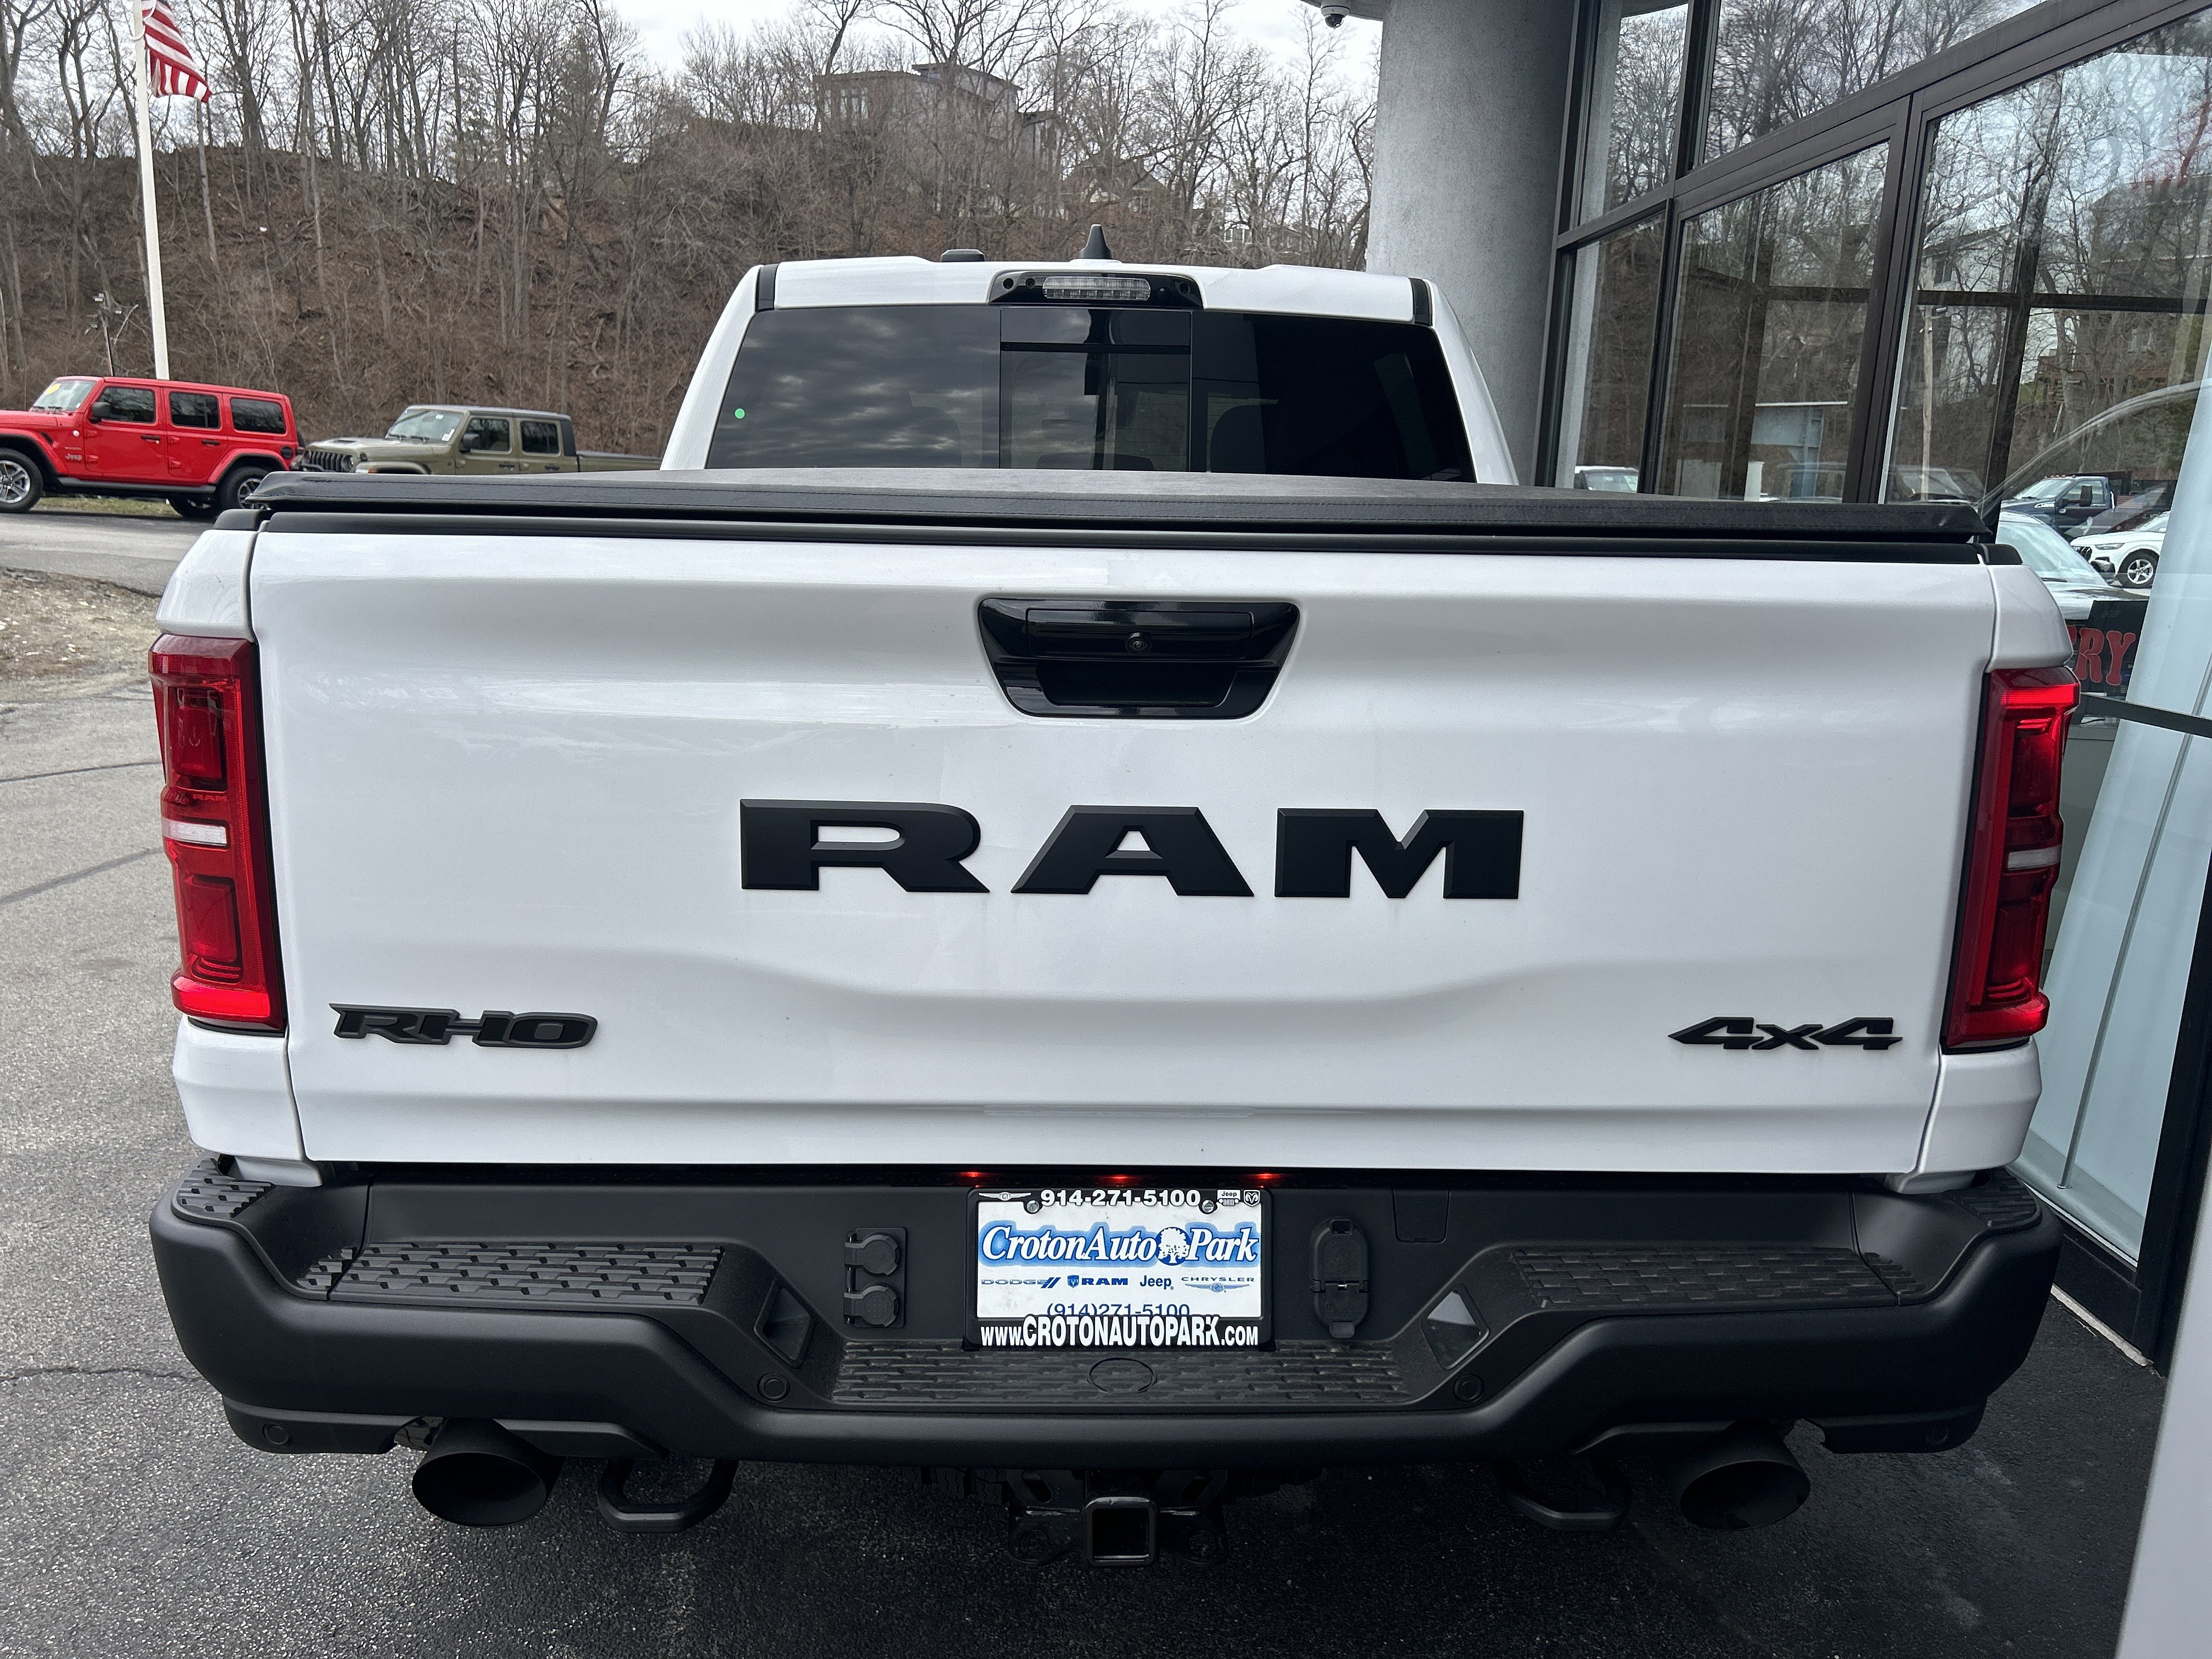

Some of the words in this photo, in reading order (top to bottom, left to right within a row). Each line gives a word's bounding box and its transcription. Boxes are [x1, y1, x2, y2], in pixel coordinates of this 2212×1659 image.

[740, 799, 1524, 899] RAM
[329, 1003, 598, 1049] RHO
[1668, 1016, 1903, 1050] 4x4
[1041, 1189, 1200, 1206] 914-271-5100
[1185, 1226, 1260, 1262] Park
[1081, 1277, 1128, 1286] RAM
[1139, 1276, 1171, 1289] Jeep
